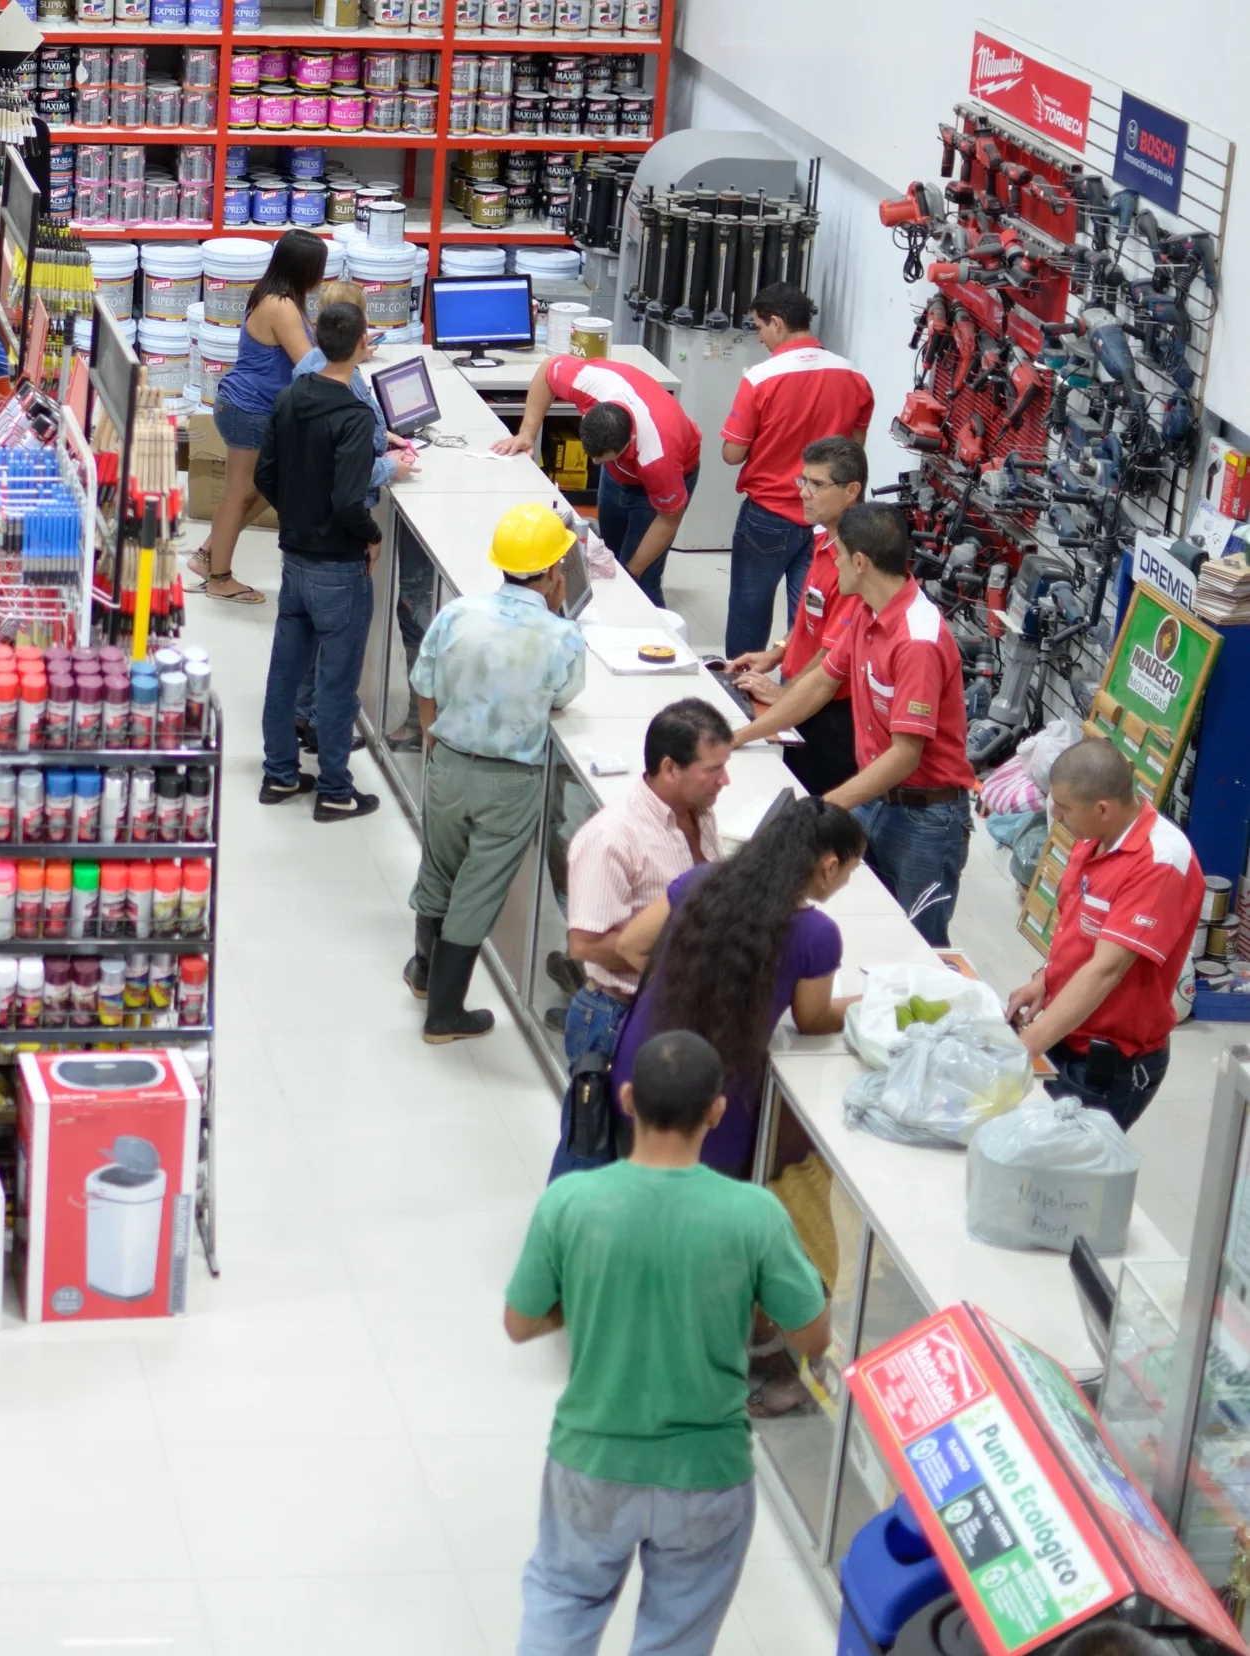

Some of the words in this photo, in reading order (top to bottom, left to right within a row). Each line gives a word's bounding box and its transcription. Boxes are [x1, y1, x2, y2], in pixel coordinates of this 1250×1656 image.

[155, 7, 186, 15] EXPRESS
[234, 9, 261, 17] XPRESS
[16, 62, 37, 71] AXIM
[41, 61, 71, 71] MAXIMA
[975, 44, 1024, 80] Milwaukee
[40, 102, 70, 111] MAXIMA
[515, 111, 544, 119] MAXIMA
[551, 111, 579, 119] MAXIMA
[1043, 105, 1083, 138] TORNECA
[1139, 130, 1176, 168] BOSCH
[292, 160, 319, 168] EXPRESS
[472, 161, 499, 169] SUPRA
[1123, 150, 1148, 171] Innovación
[1147, 163, 1159, 178] para
[1163, 170, 1174, 186] vida
[547, 167, 572, 175] MAXIM
[260, 206, 287, 214] EXPRESS
[292, 207, 319, 215] EXPRESS
[335, 205, 355, 213] SUPR
[482, 208, 507, 217] SUPRA
[363, 283, 381, 293] anco
[151, 296, 195, 307] SUPER-COA
[206, 299, 246, 312] SUPER-CO
[572, 347, 587, 357] PRA
[1140, 548, 1195, 615] DREMEL
[1131, 646, 1180, 696] MADECO
[1128, 675, 1168, 713] MOLDURAS
[174, 1197, 190, 1256] automatic
[910, 1339, 957, 1412] Materiales
[975, 1422, 1021, 1487] Punto
[1010, 1483, 1078, 1586] Ecológico
[976, 1489, 995, 1516] PAPEL
